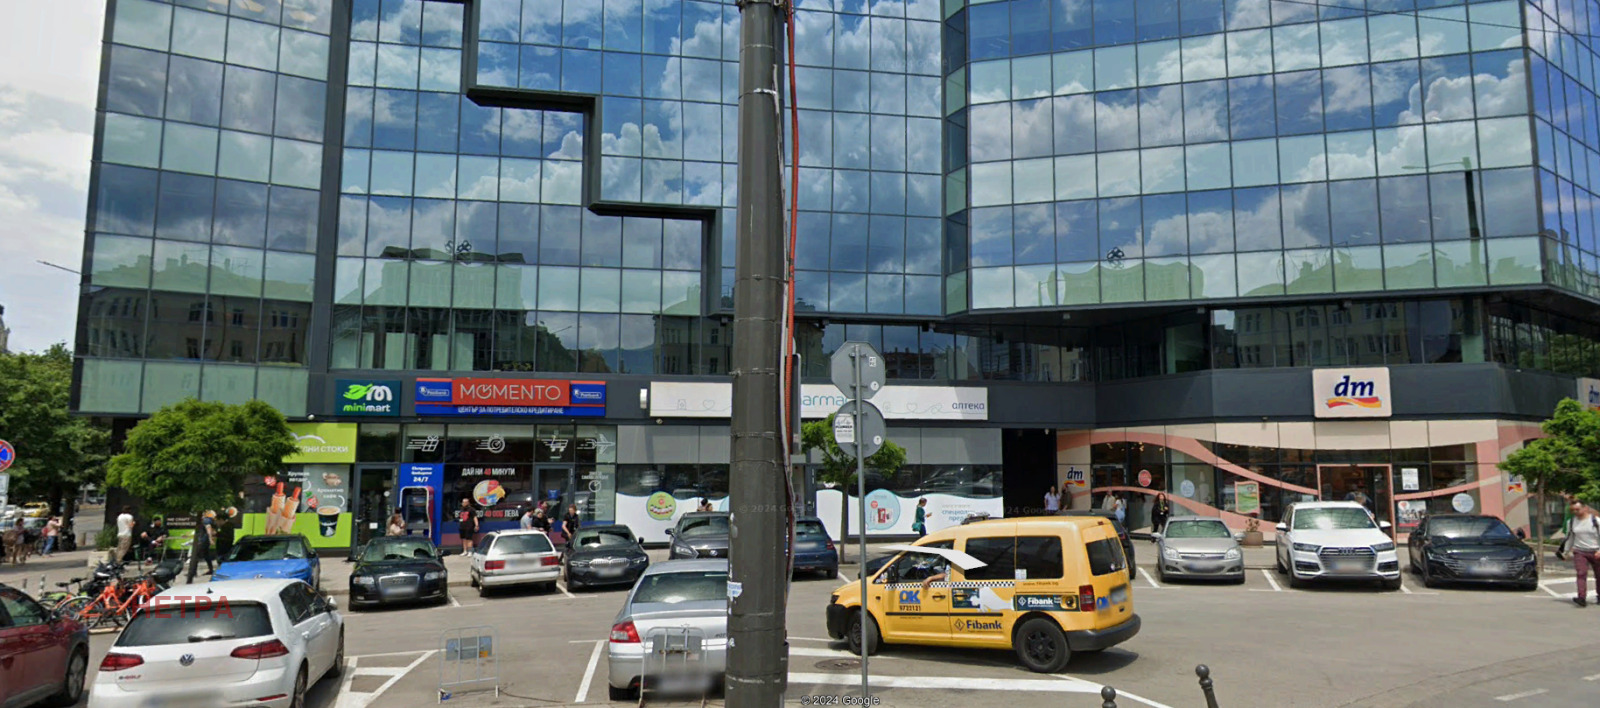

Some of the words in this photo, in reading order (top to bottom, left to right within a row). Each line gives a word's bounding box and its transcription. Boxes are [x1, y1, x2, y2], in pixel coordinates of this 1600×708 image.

[1334, 375, 1374, 396] dm
[460, 384, 561, 400] MOMENTO
[343, 403, 391, 412] minimart
[952, 401, 985, 409] аптека
[462, 468, 475, 476] ДАЙ
[475, 468, 483, 476] НИ
[492, 468, 516, 476] МИНУТИ
[1067, 467, 1083, 480] dm
[504, 510, 519, 518] ЛЕВА
[900, 590, 921, 604] OK
[1027, 597, 1054, 605] Fibank
[966, 620, 1002, 630] Fibank
